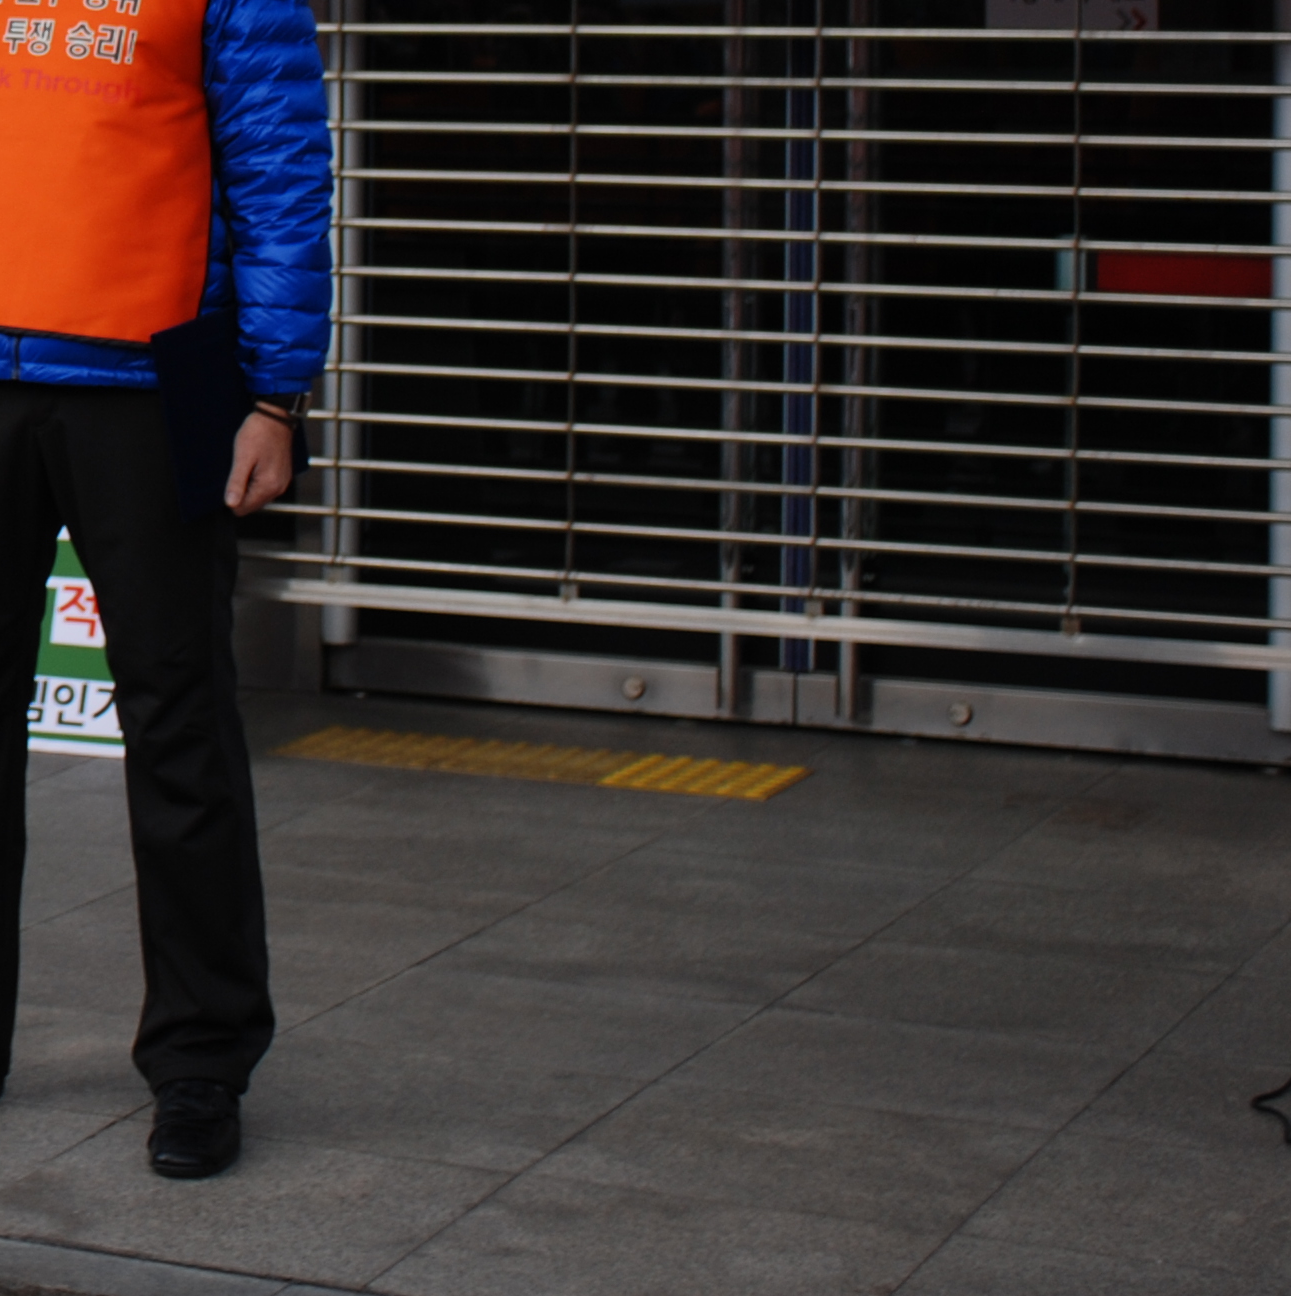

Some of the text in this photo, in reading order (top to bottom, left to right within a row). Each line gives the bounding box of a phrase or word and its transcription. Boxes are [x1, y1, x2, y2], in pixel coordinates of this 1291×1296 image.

[3, 19, 55, 56] 투쟁
[65, 22, 137, 64] 승리!
[21, 67, 143, 103] Through
